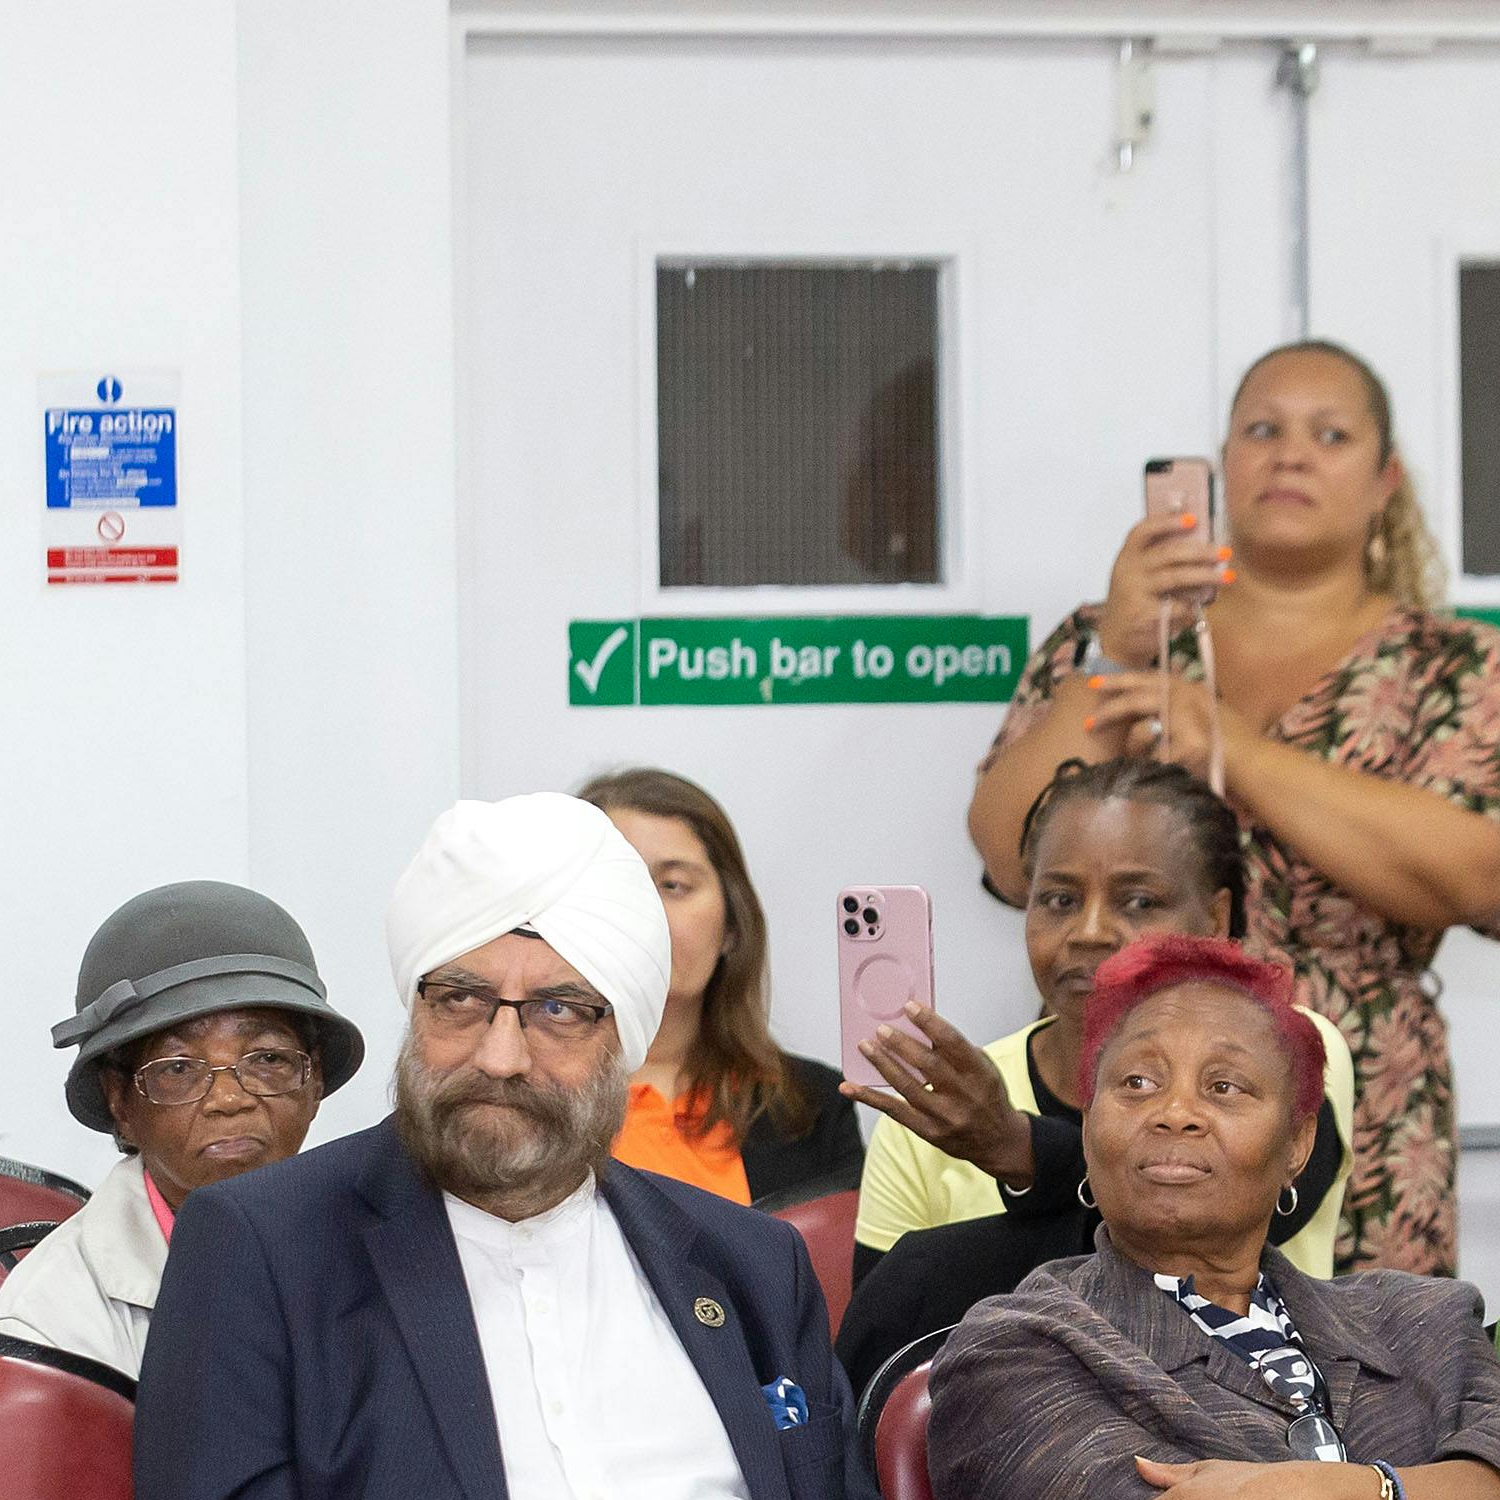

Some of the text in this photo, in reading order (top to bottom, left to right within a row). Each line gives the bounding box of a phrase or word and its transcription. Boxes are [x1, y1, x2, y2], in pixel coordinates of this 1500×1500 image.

[49, 410, 173, 434] Fire action
[647, 637, 1013, 686] Push bar to open
